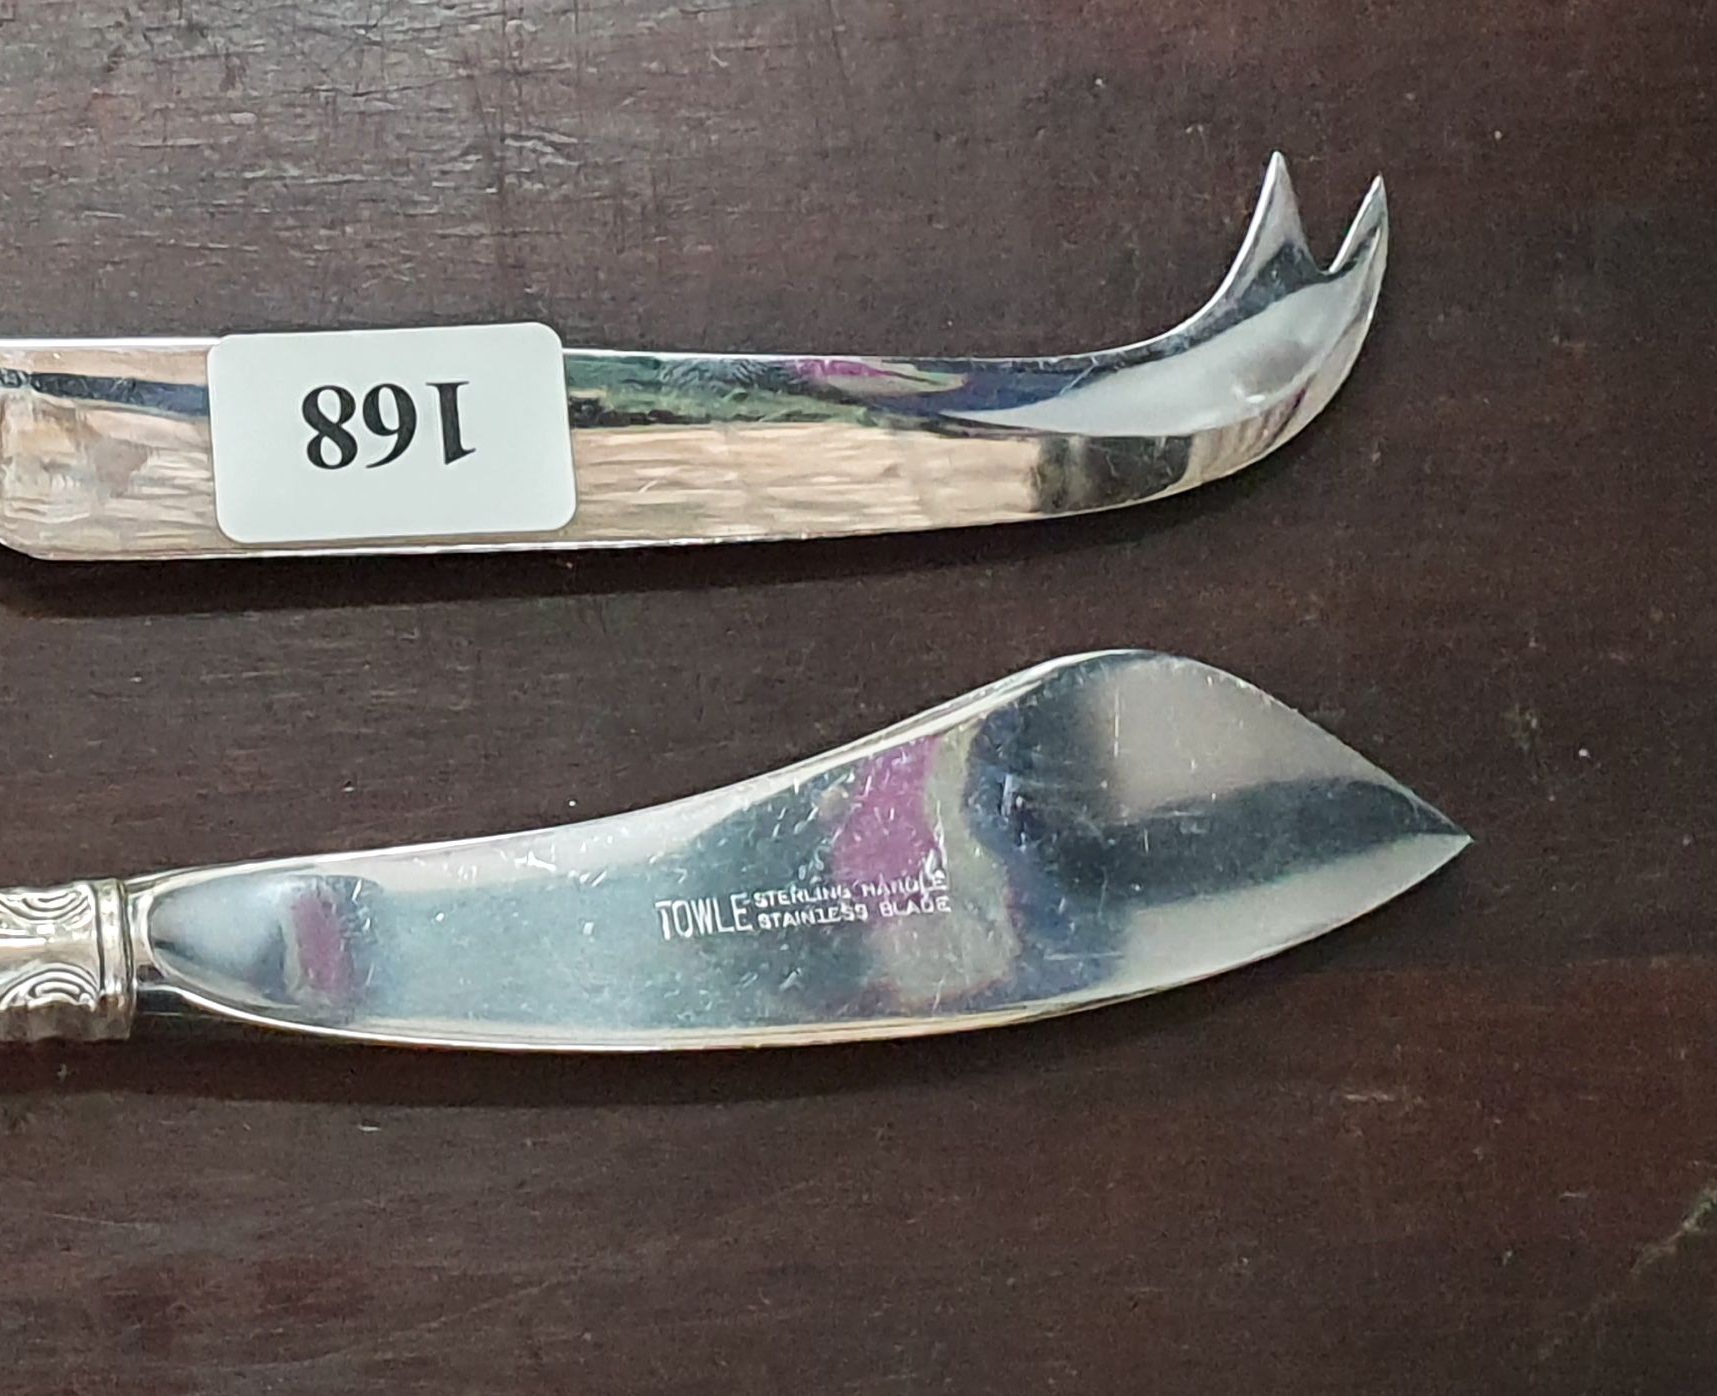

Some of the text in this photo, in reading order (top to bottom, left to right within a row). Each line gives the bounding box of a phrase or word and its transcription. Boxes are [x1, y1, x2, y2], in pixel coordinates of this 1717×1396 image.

[301, 380, 476, 470] 168
[754, 871, 948, 909] STERLING HANDLE
[654, 892, 754, 941] TOWLE
[757, 895, 952, 930] STAINLESS BLADE
